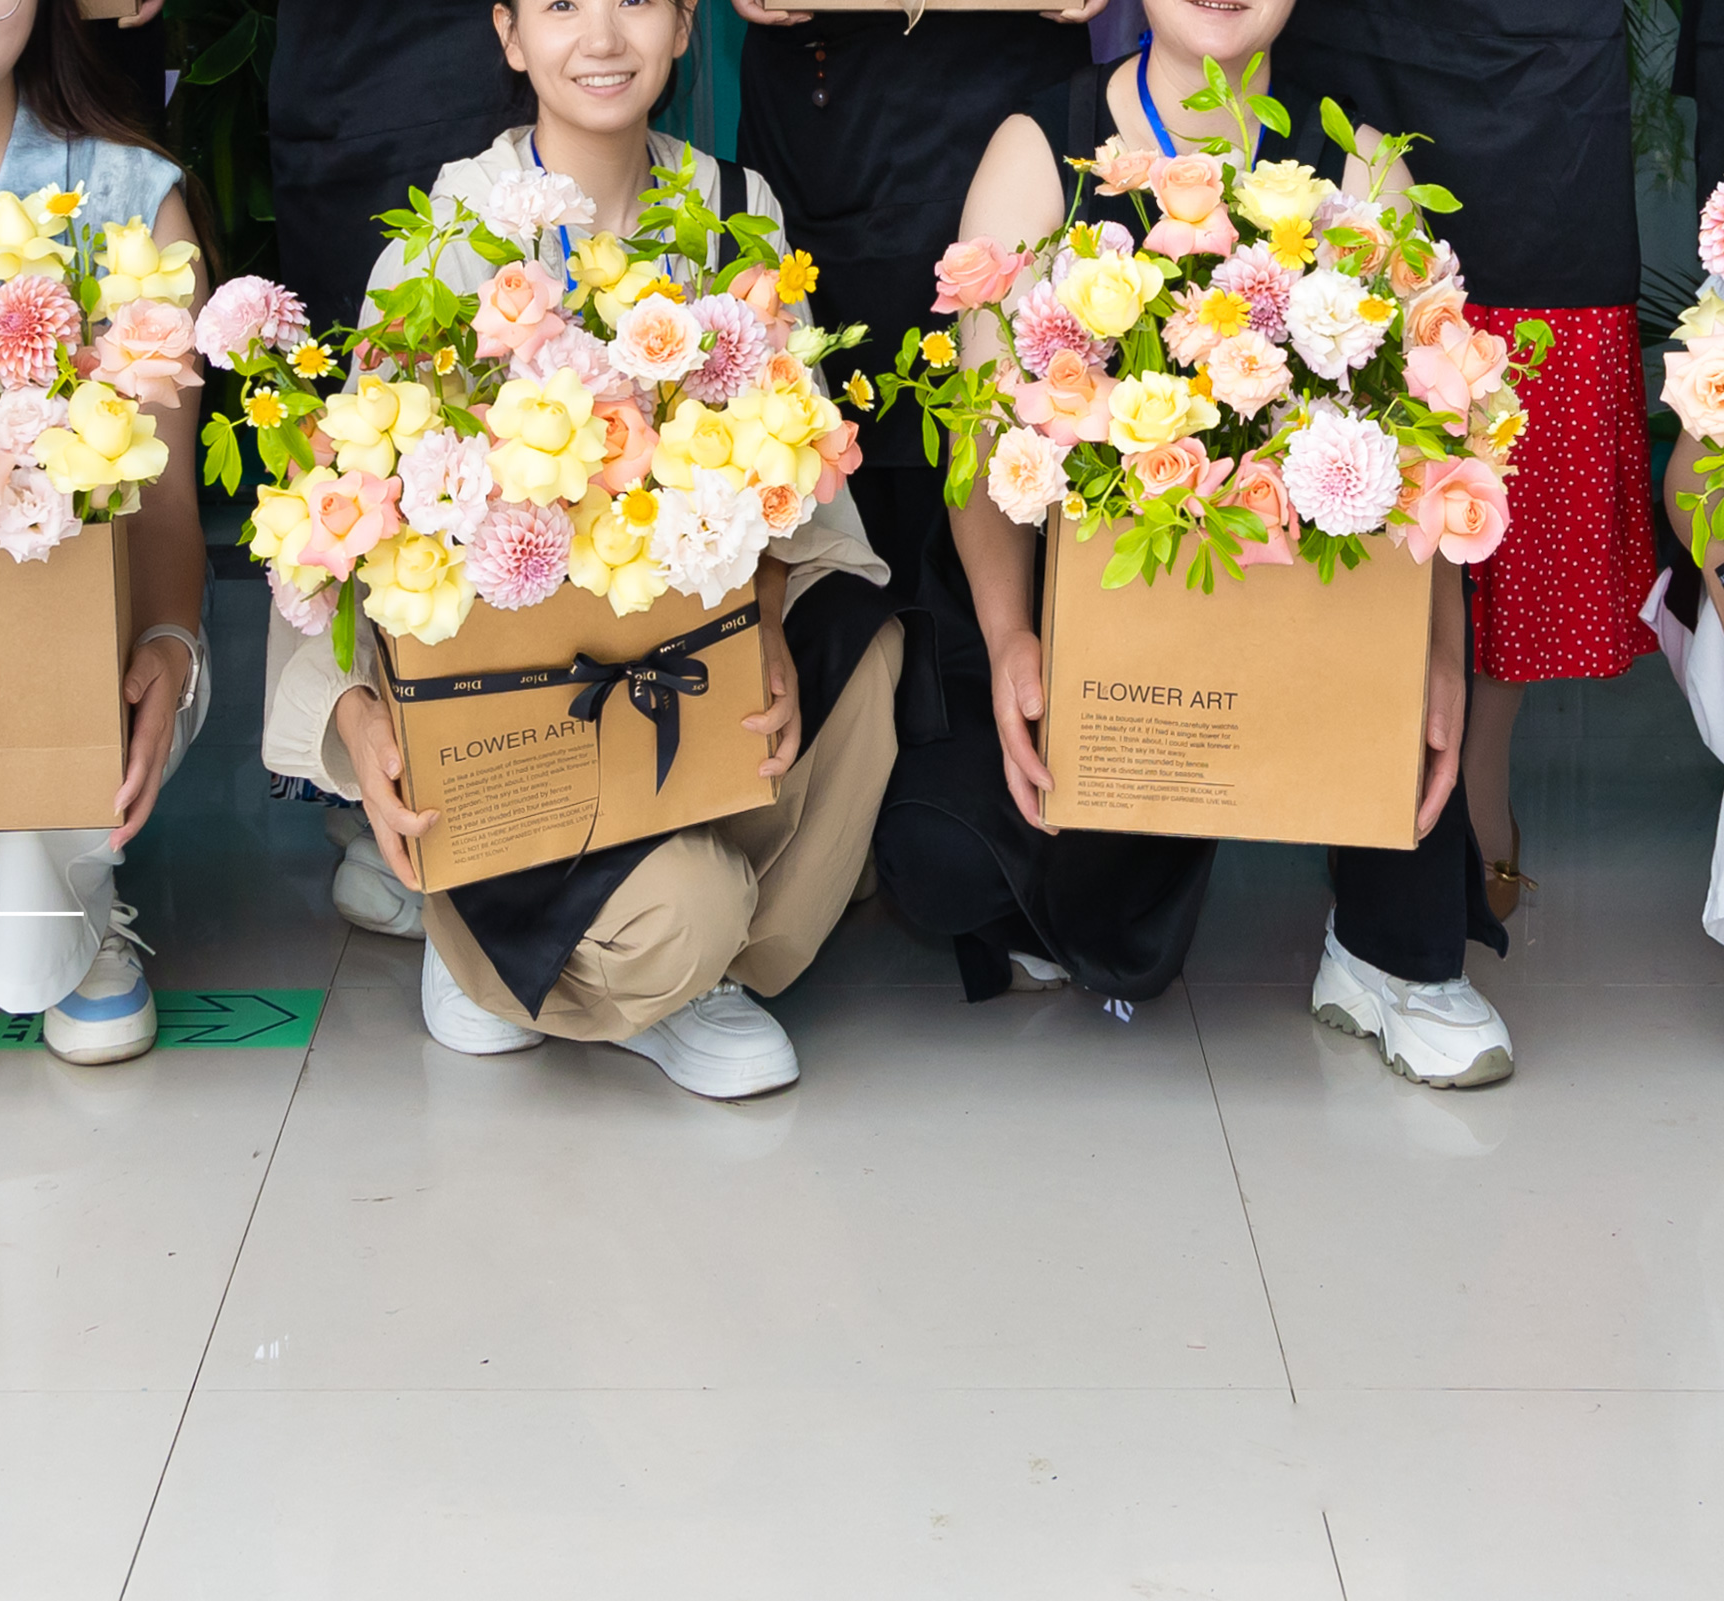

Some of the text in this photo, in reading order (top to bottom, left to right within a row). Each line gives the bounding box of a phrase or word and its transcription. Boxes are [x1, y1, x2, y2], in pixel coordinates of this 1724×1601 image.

[720, 613, 747, 633] Dior
[453, 679, 482, 692] Dior
[520, 672, 548, 684] Dior
[1083, 681, 1238, 710] FLOWER ART
[439, 719, 588, 766] FLOWER ART
